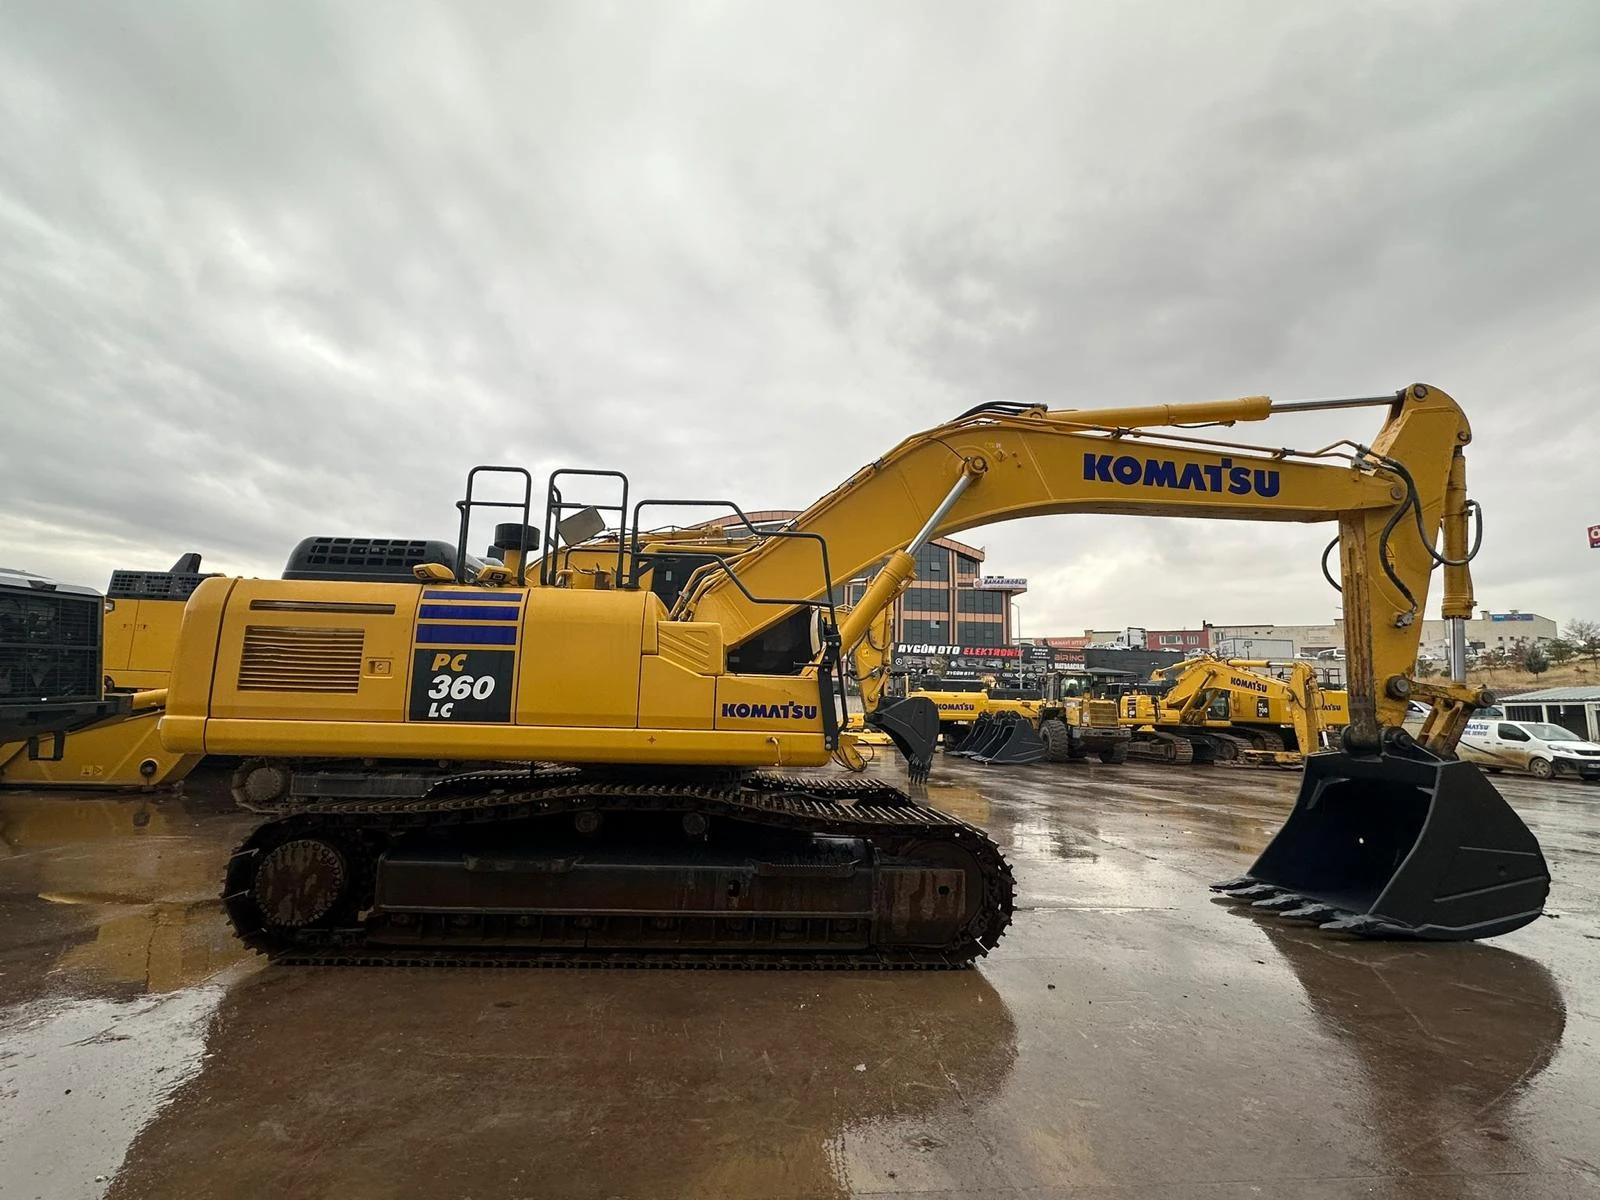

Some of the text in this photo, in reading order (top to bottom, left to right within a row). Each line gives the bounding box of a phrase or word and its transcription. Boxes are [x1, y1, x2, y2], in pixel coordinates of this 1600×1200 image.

[1083, 453, 1280, 498] KOMATSU
[937, 645, 960, 655] OTO
[431, 653, 468, 672] PC
[428, 674, 496, 700] 360
[1230, 677, 1267, 692] KOMATSU
[428, 702, 454, 718] LC
[722, 701, 817, 719] KOMATSU
